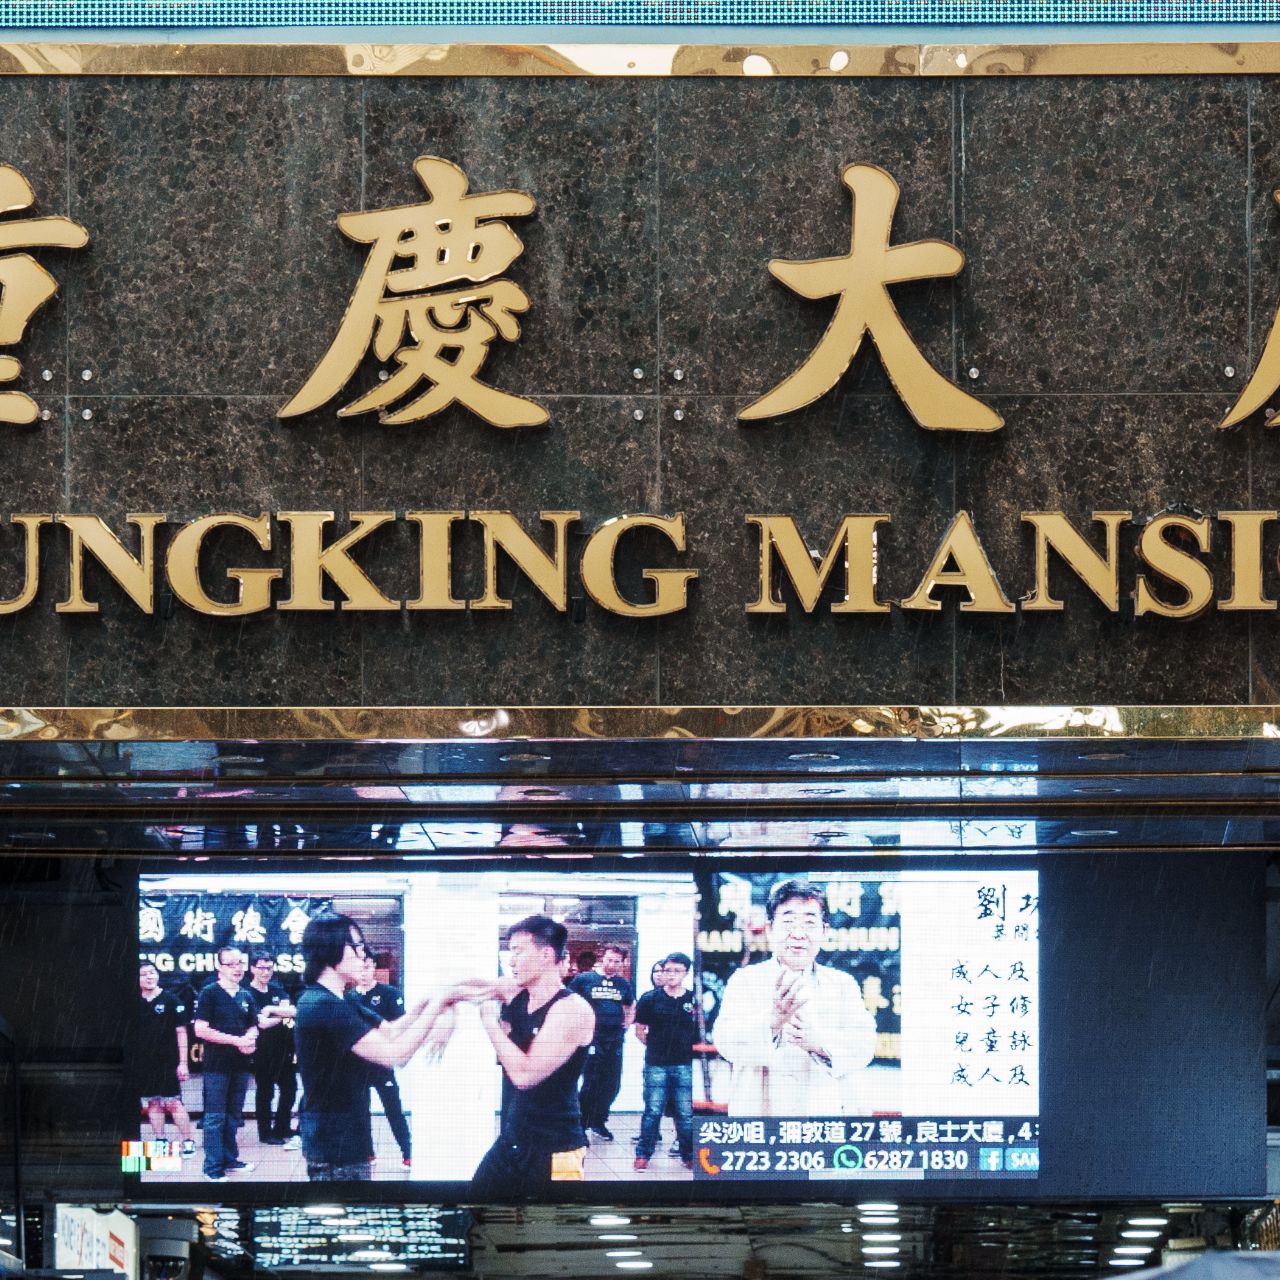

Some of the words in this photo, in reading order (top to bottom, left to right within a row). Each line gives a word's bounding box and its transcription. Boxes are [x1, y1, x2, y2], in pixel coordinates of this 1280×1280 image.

[721, 1150, 771, 1171] 2723
[775, 1150, 825, 1171] 2306
[863, 1150, 913, 1171] 6287
[919, 1150, 969, 1171] 1830
